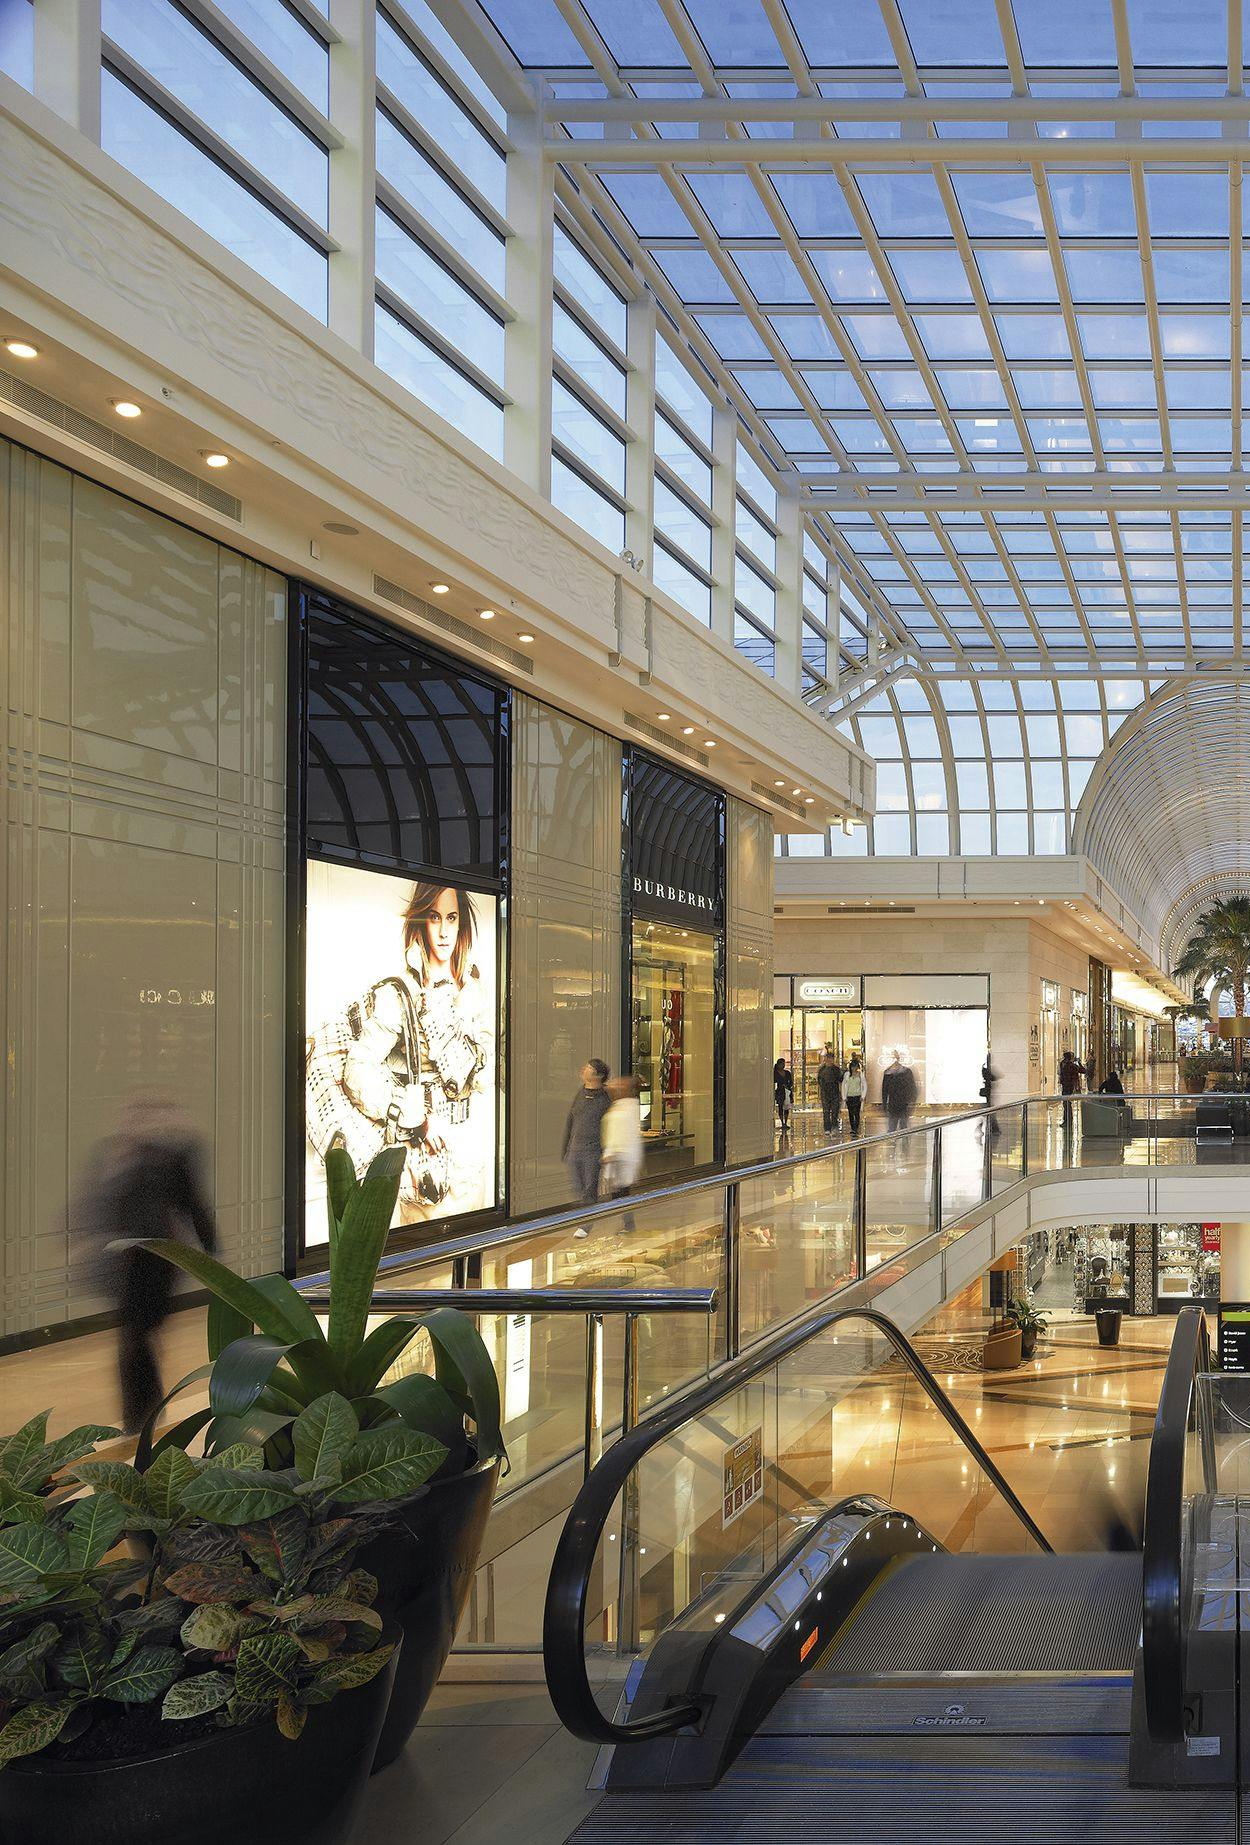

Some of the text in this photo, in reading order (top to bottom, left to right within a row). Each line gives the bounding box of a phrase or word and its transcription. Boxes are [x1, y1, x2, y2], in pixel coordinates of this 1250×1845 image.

[633, 877, 715, 911] BURBERRY
[1204, 1227, 1221, 1235] half
[914, 1716, 985, 1726] Schindler
